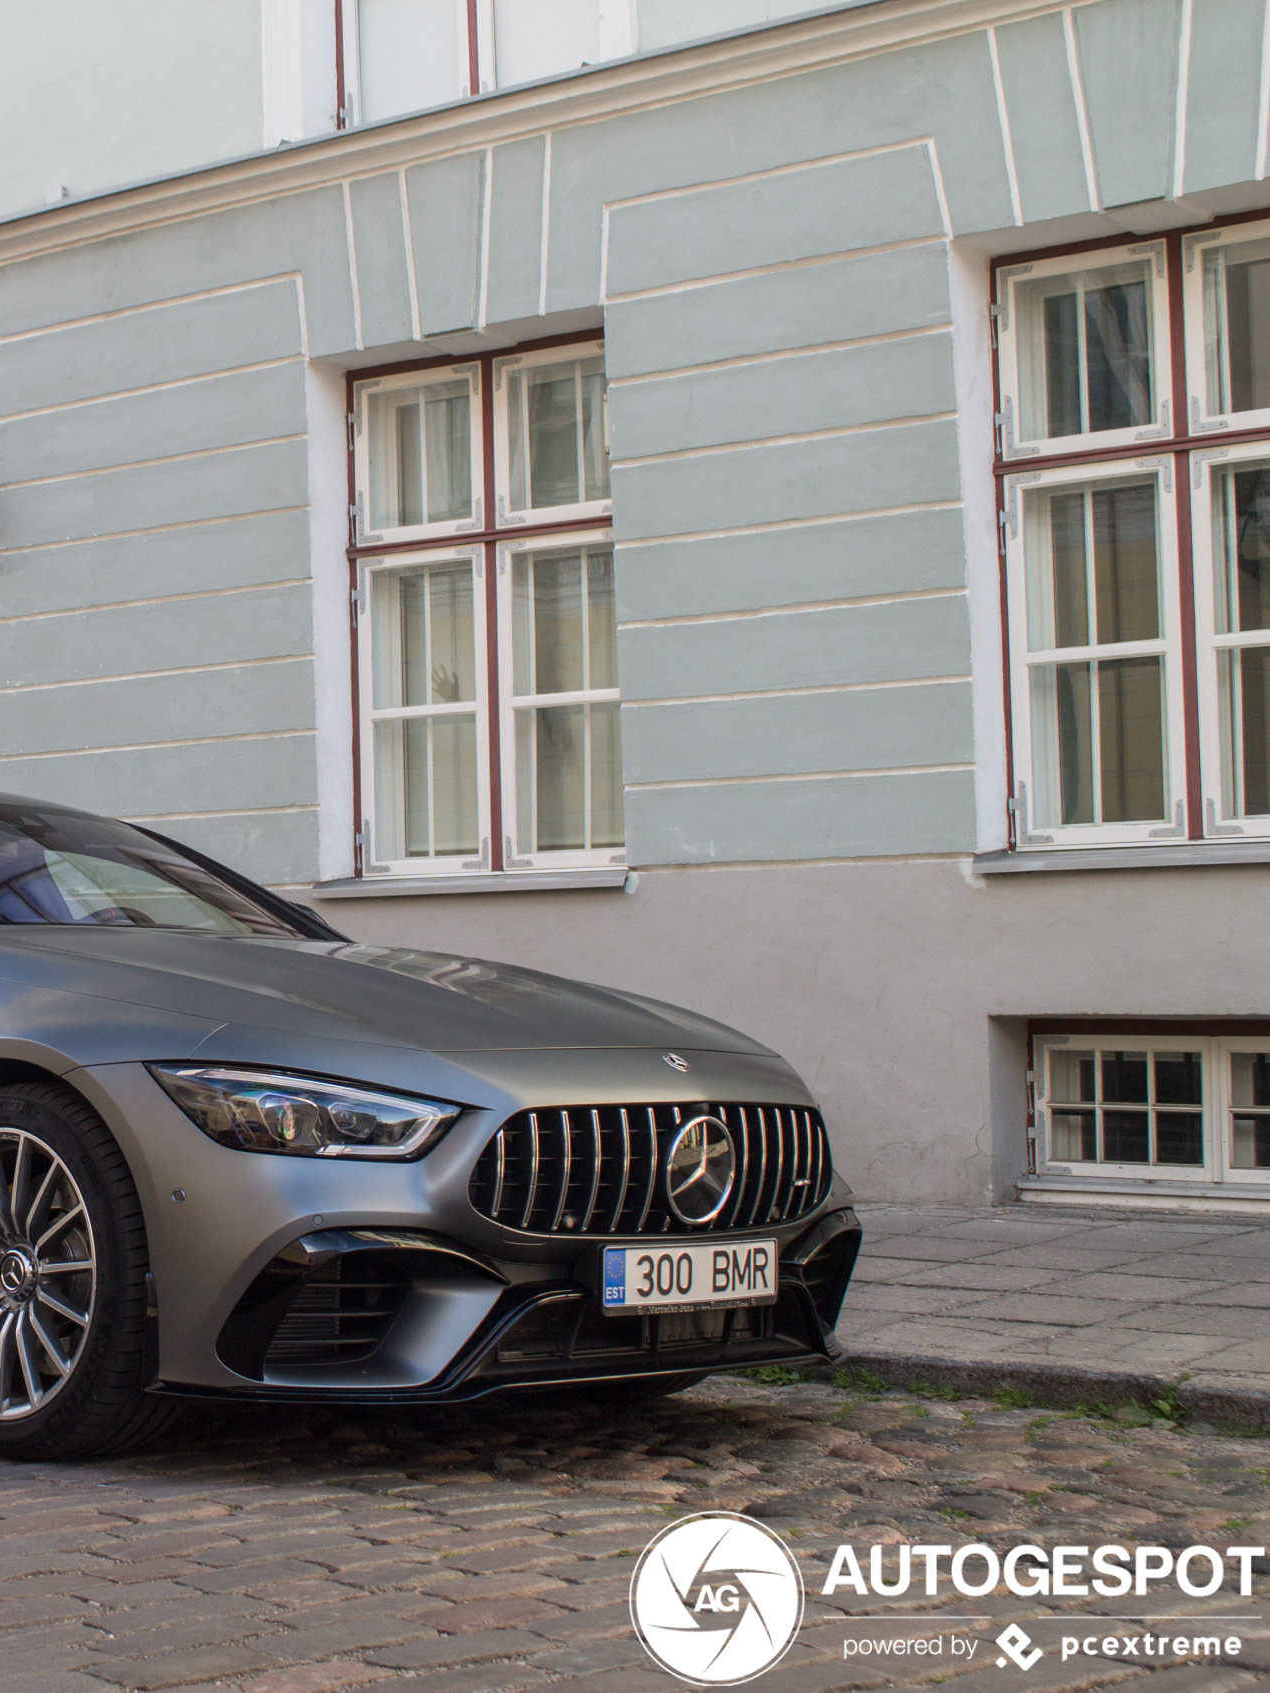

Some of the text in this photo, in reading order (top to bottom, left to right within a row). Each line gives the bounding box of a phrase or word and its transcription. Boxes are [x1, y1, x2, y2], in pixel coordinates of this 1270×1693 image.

[636, 1247, 768, 1298] 300 BMR
[606, 1287, 625, 1300] EST
